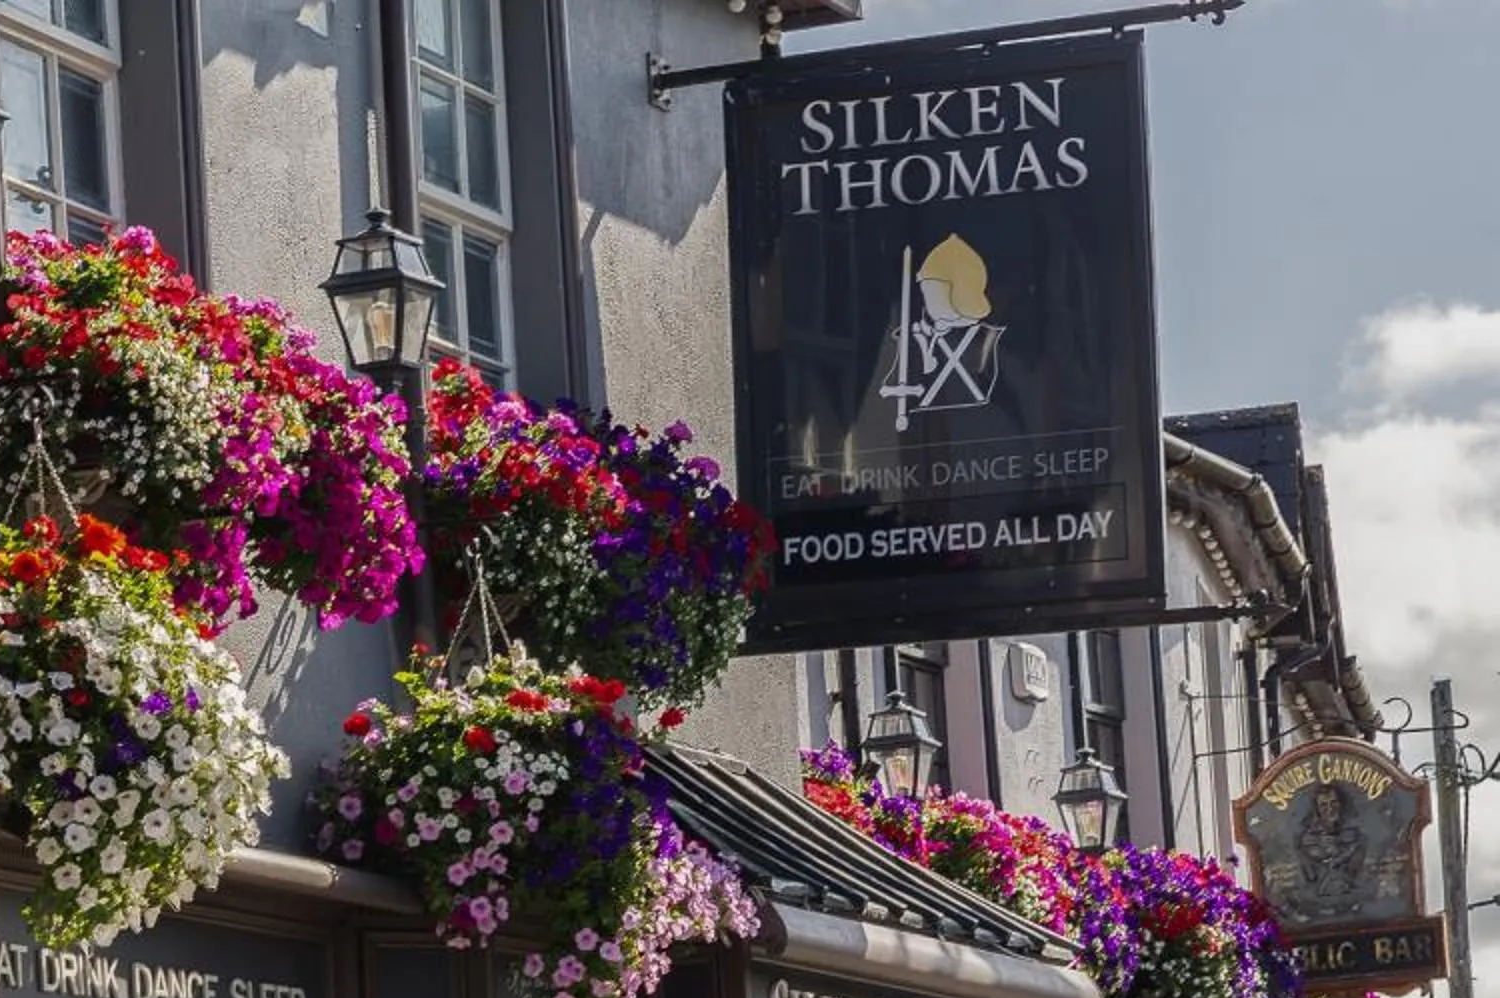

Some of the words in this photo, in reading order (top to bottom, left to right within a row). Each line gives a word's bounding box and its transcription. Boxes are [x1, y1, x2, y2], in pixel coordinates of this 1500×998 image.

[800, 77, 1067, 155] SILKEN
[781, 136, 1089, 217] THOMAS
[781, 473, 825, 499] EAT
[840, 464, 920, 494] DRINK
[931, 455, 1023, 486] DANCE
[1032, 447, 1110, 477] SLEEP
[783, 531, 865, 566] FOOD
[870, 521, 987, 559] SERVED
[993, 514, 1052, 548] ALL
[1057, 508, 1115, 543] DAY
[1262, 761, 1317, 811] SQUIRE
[1373, 934, 1434, 965] BAR
